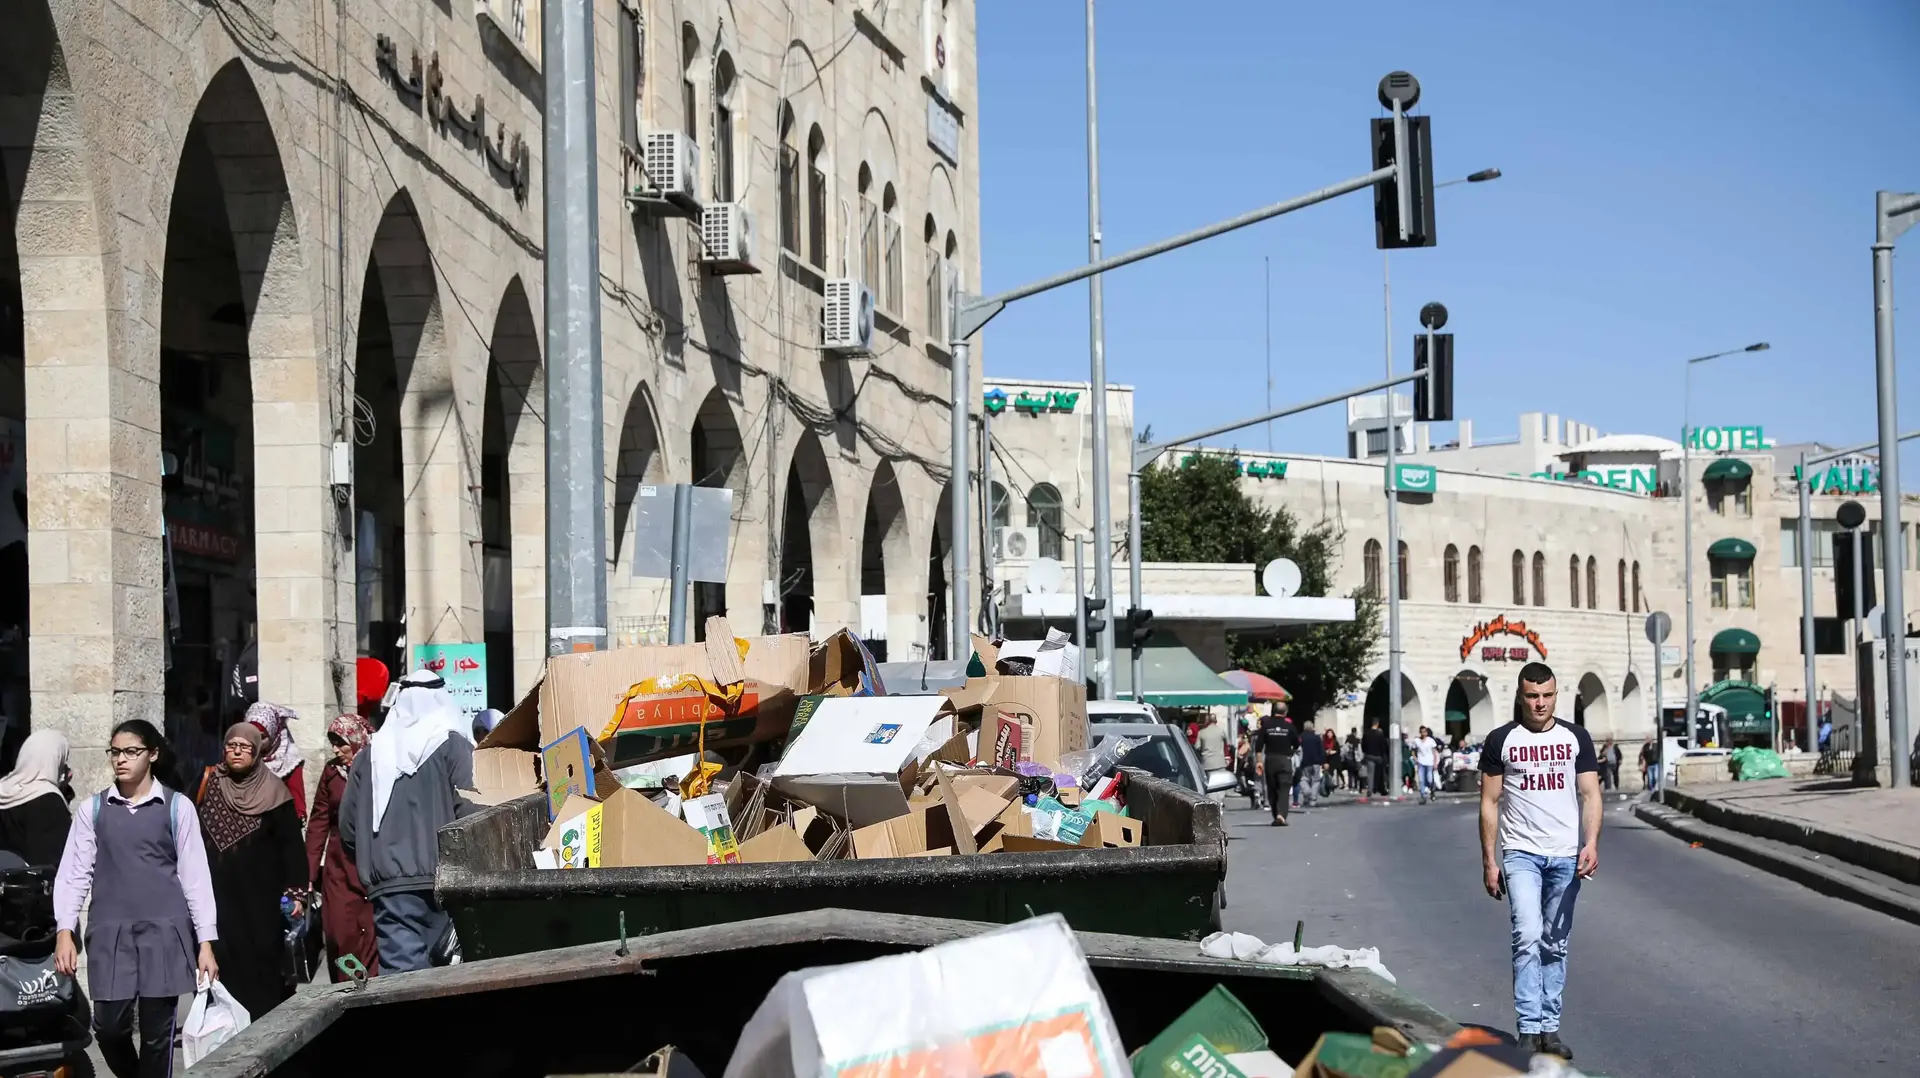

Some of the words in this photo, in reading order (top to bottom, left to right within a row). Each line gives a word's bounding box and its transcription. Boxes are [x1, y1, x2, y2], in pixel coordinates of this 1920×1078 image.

[1682, 425, 1772, 451] HOTEL
[1508, 467, 1657, 492] DEN
[1794, 465, 1880, 492] WALL
[167, 522, 240, 557] HARMACY
[636, 702, 735, 721] obilya
[793, 699, 807, 728] CITRUS
[803, 700, 814, 725] ISRAEL
[1509, 744, 1572, 762] CONCISE
[1520, 773, 1565, 791] JEANS
